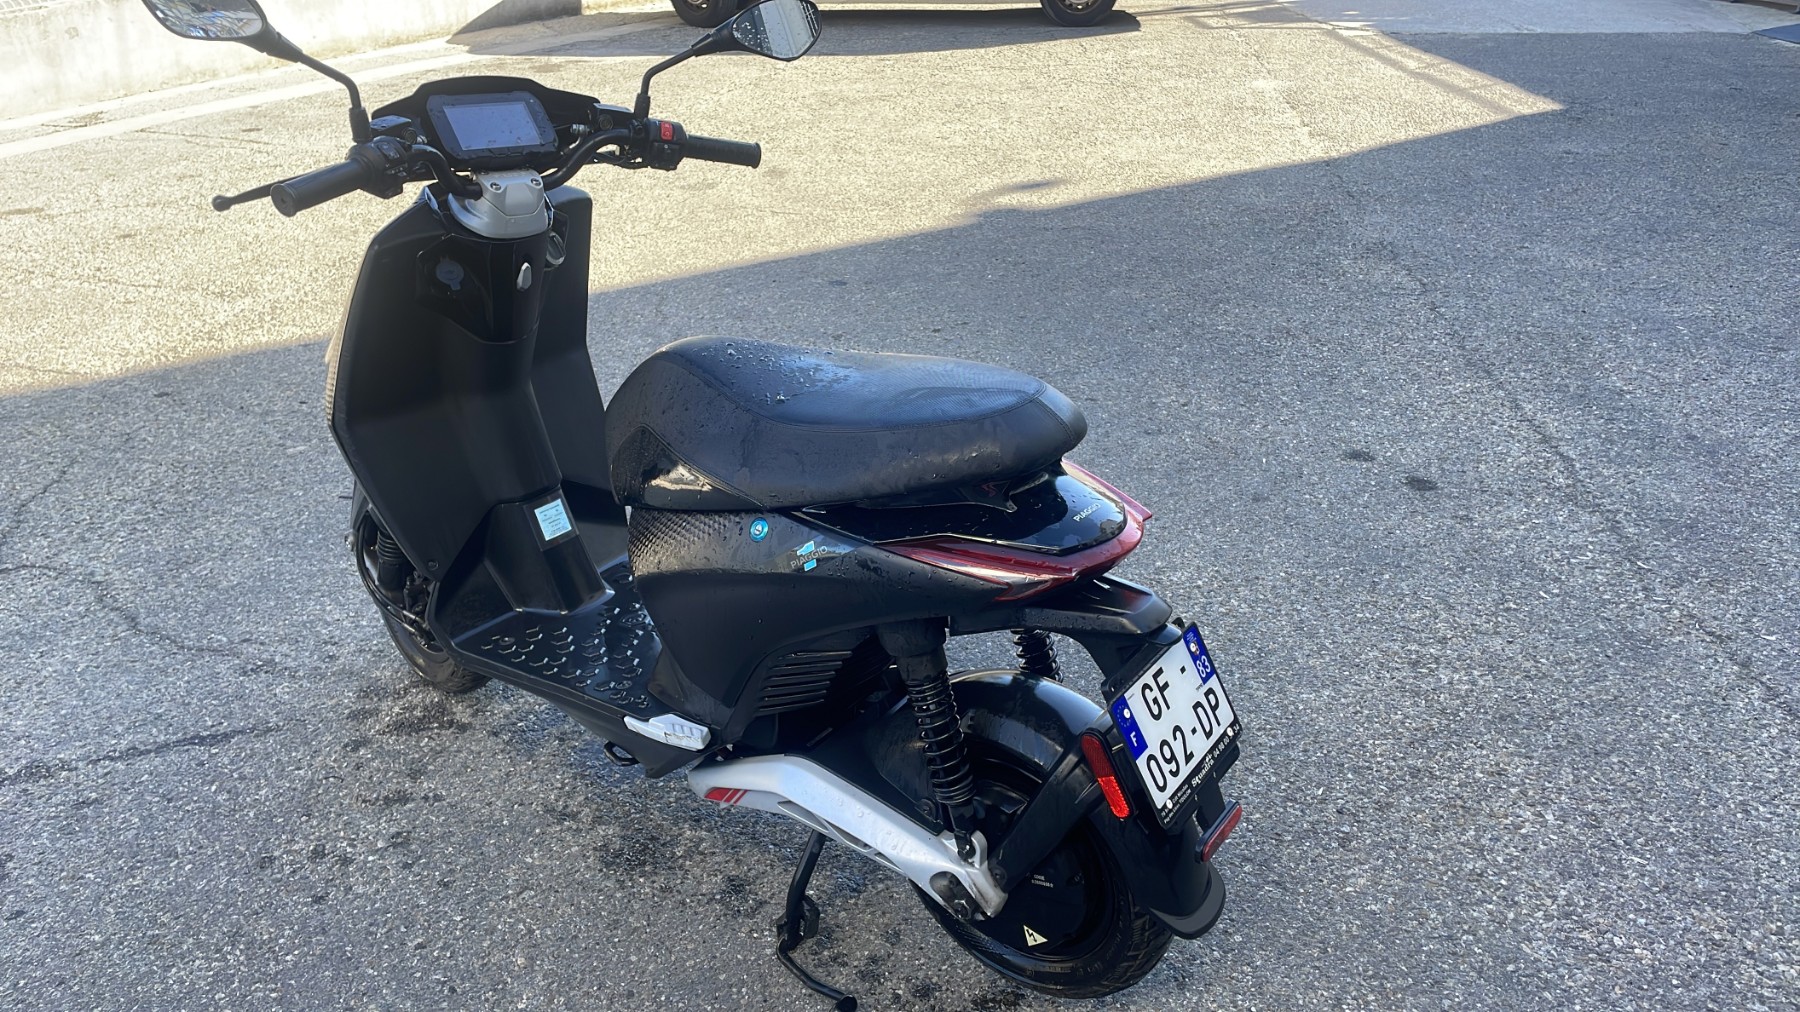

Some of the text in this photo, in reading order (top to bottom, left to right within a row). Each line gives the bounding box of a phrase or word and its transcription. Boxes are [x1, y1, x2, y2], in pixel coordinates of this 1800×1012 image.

[1072, 503, 1101, 522] PIAGGIO
[790, 545, 828, 569] PIAGGIO
[1196, 655, 1211, 678] 83
[1130, 732, 1138, 747] F
[1145, 687, 1221, 793] 092-DP
[1191, 758, 1215, 787] Squadra
